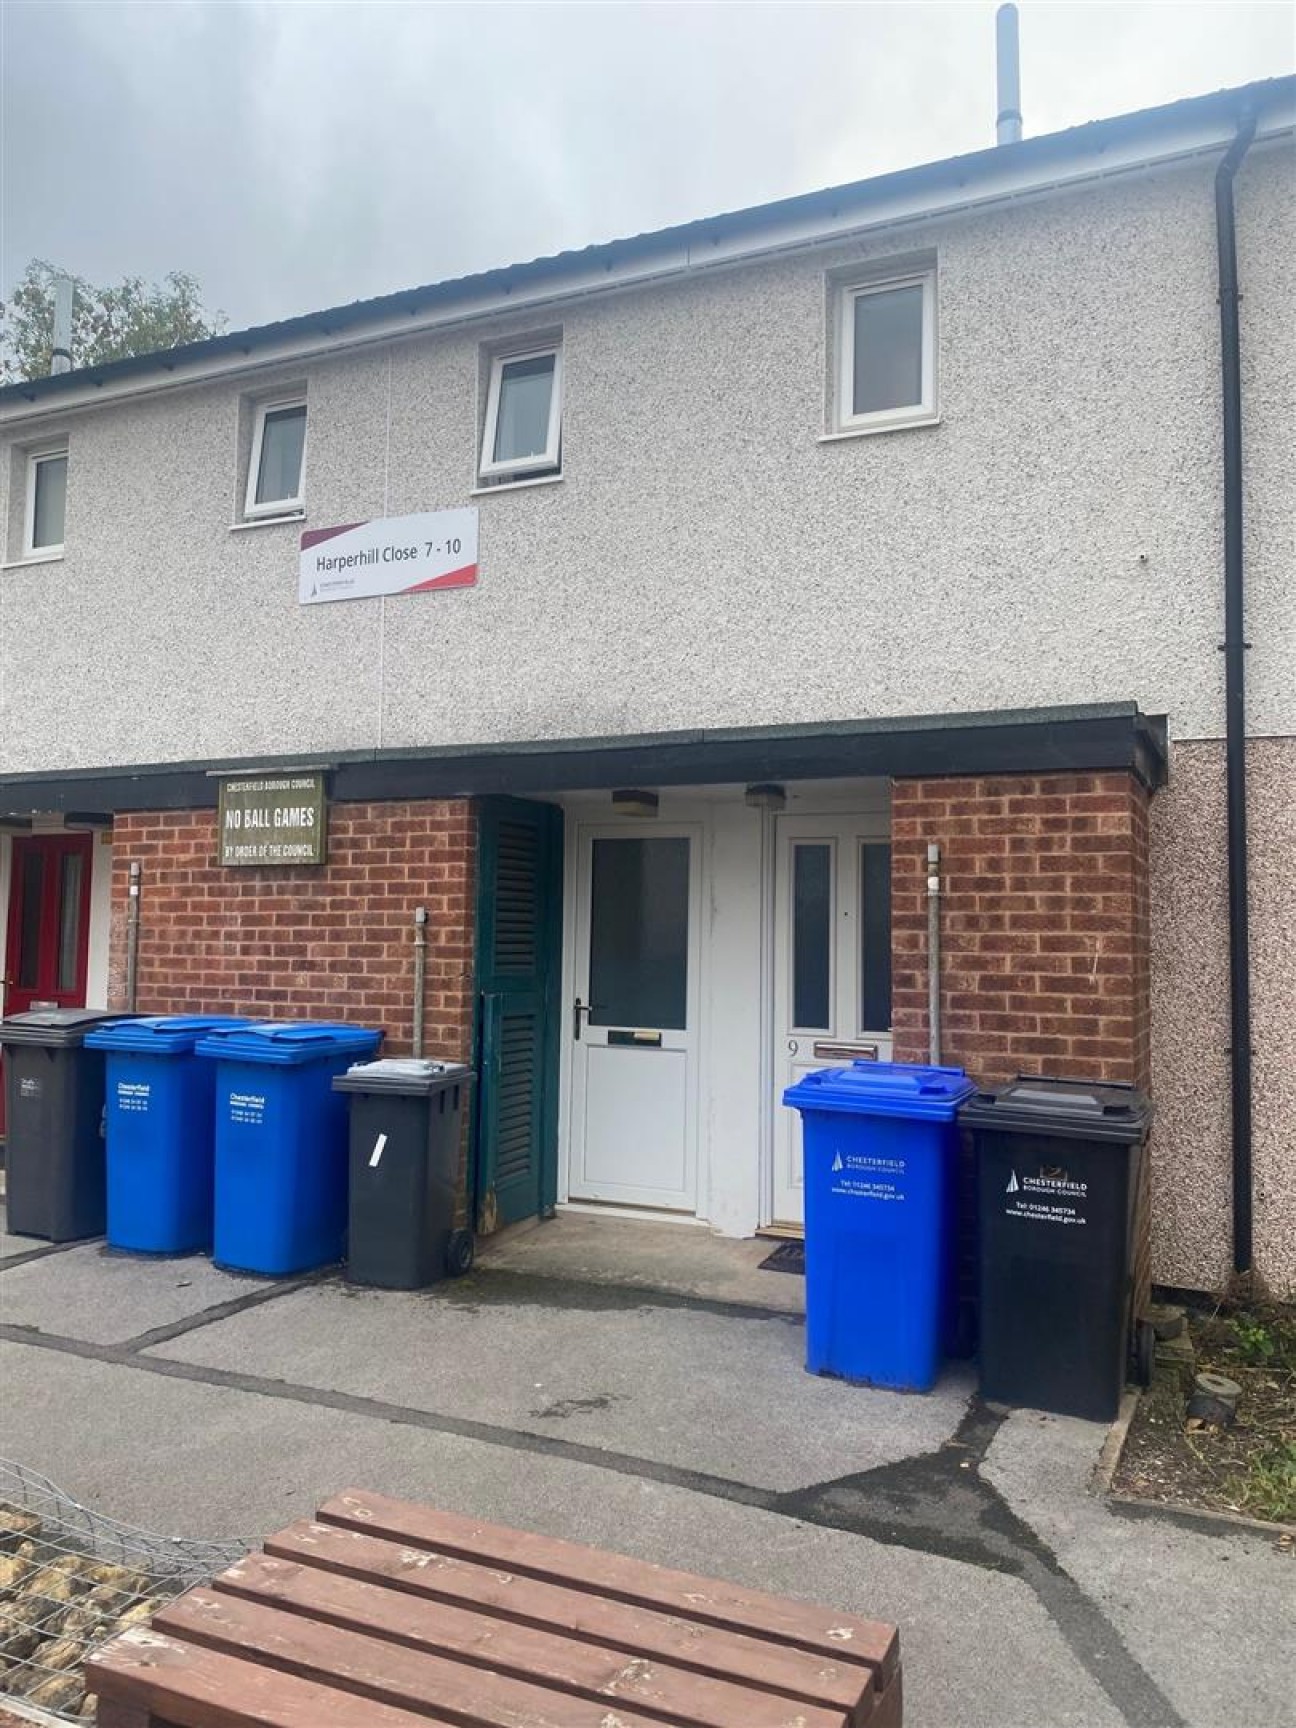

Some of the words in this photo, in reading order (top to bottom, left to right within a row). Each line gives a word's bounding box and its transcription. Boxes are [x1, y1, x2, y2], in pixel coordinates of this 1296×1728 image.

[316, 550, 379, 572] Harperhill
[382, 545, 418, 563] Close
[425, 542, 433, 557] 7
[446, 538, 462, 554] 10
[226, 781, 263, 793] CHESTERFIELD
[265, 780, 290, 790] BOROUGH
[291, 778, 315, 789] COUNCIL
[225, 809, 241, 830] NO
[244, 808, 271, 829] BALL
[274, 807, 315, 828] GAMES
[225, 845, 234, 857] BY
[235, 845, 257, 857] ORDER
[259, 845, 268, 857] OF
[269, 845, 281, 857] THE
[282, 844, 315, 857] COUNCIL
[788, 1039, 799, 1057] 9
[846, 1154, 906, 1168] CHESTERFIELD
[1023, 1176, 1088, 1191] CHESTERFIELD
[1023, 1184, 1056, 1194] BOROUGH
[1057, 1188, 1087, 1198] COUNCIL
[1005, 1208, 1087, 1225] www.chesterfield.gov.uk
